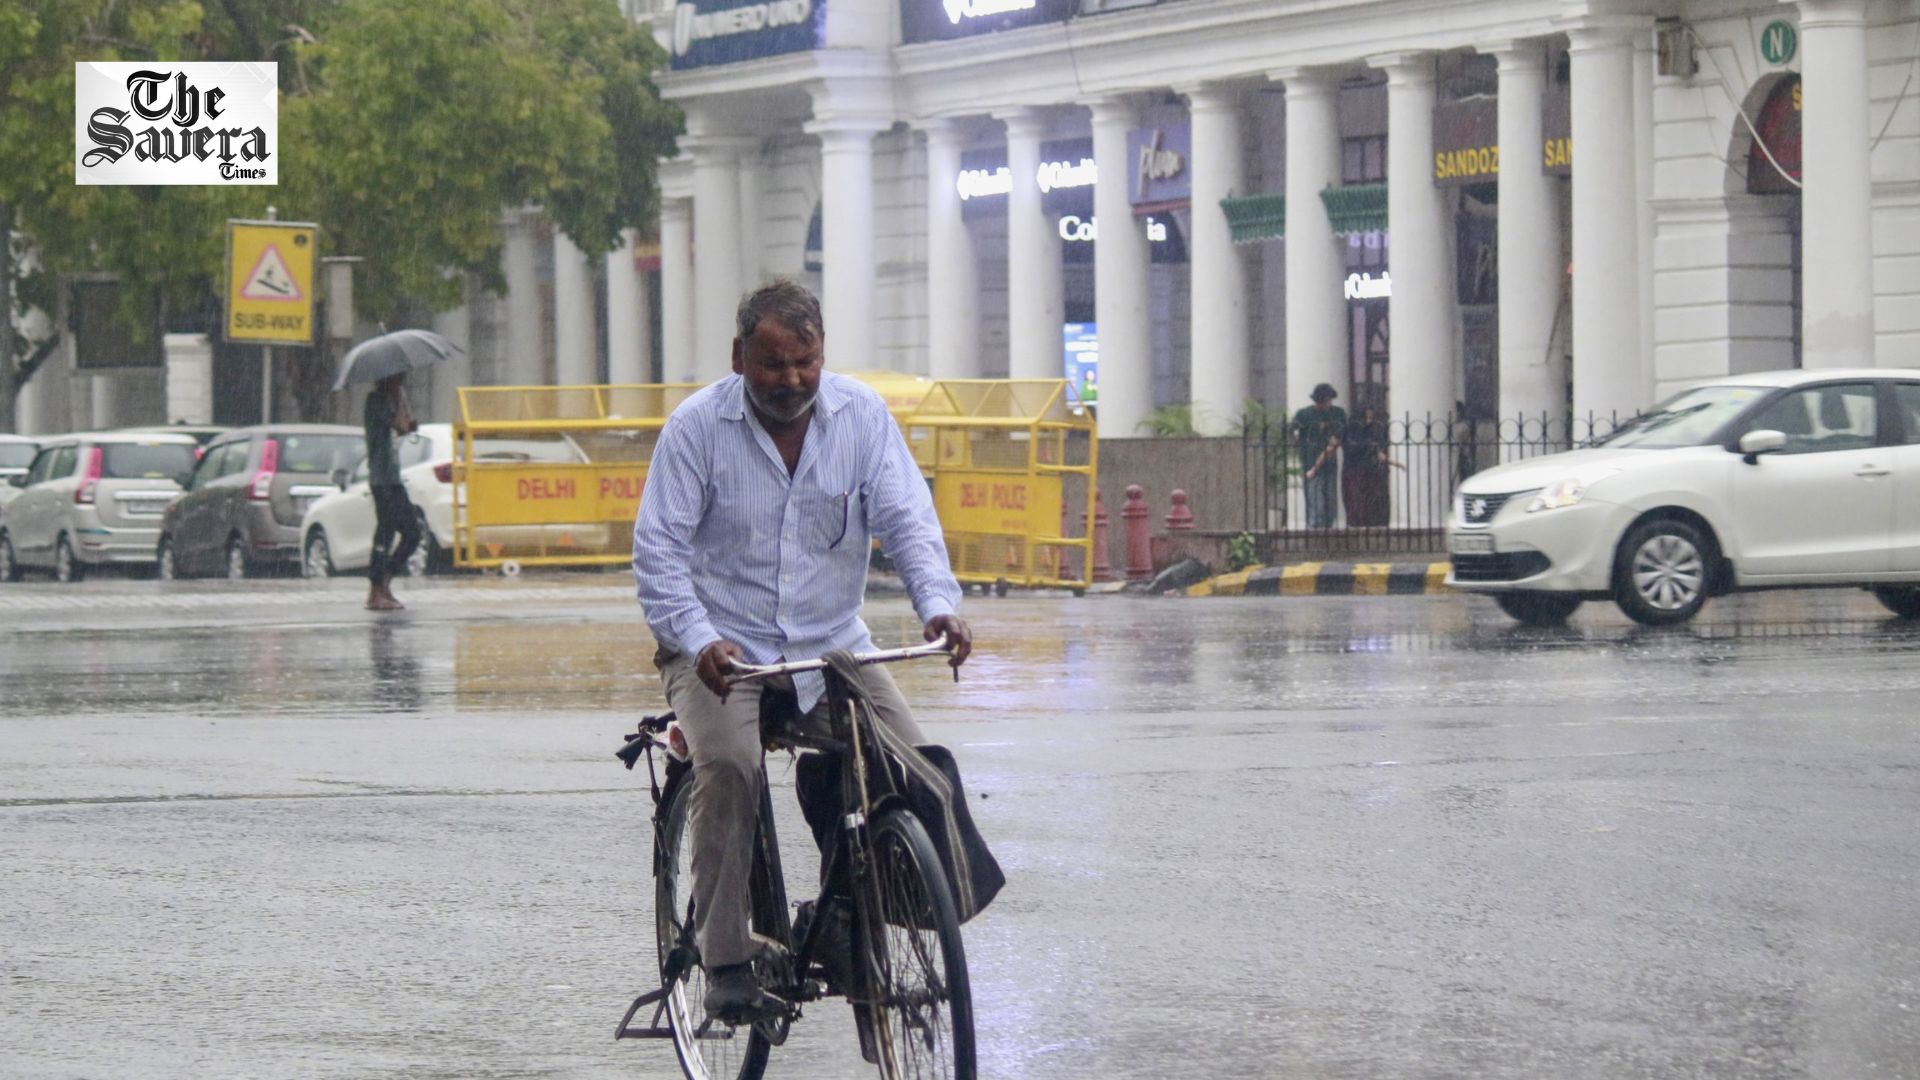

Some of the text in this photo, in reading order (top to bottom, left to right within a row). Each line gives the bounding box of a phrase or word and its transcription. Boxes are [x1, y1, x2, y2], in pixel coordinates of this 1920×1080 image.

[1769, 27, 1784, 59] N
[1435, 145, 1500, 178] SANDOZ
[1544, 137, 1573, 168] SAN
[234, 312, 305, 331] SUB-WAY
[517, 477, 645, 499] DELHI POLI
